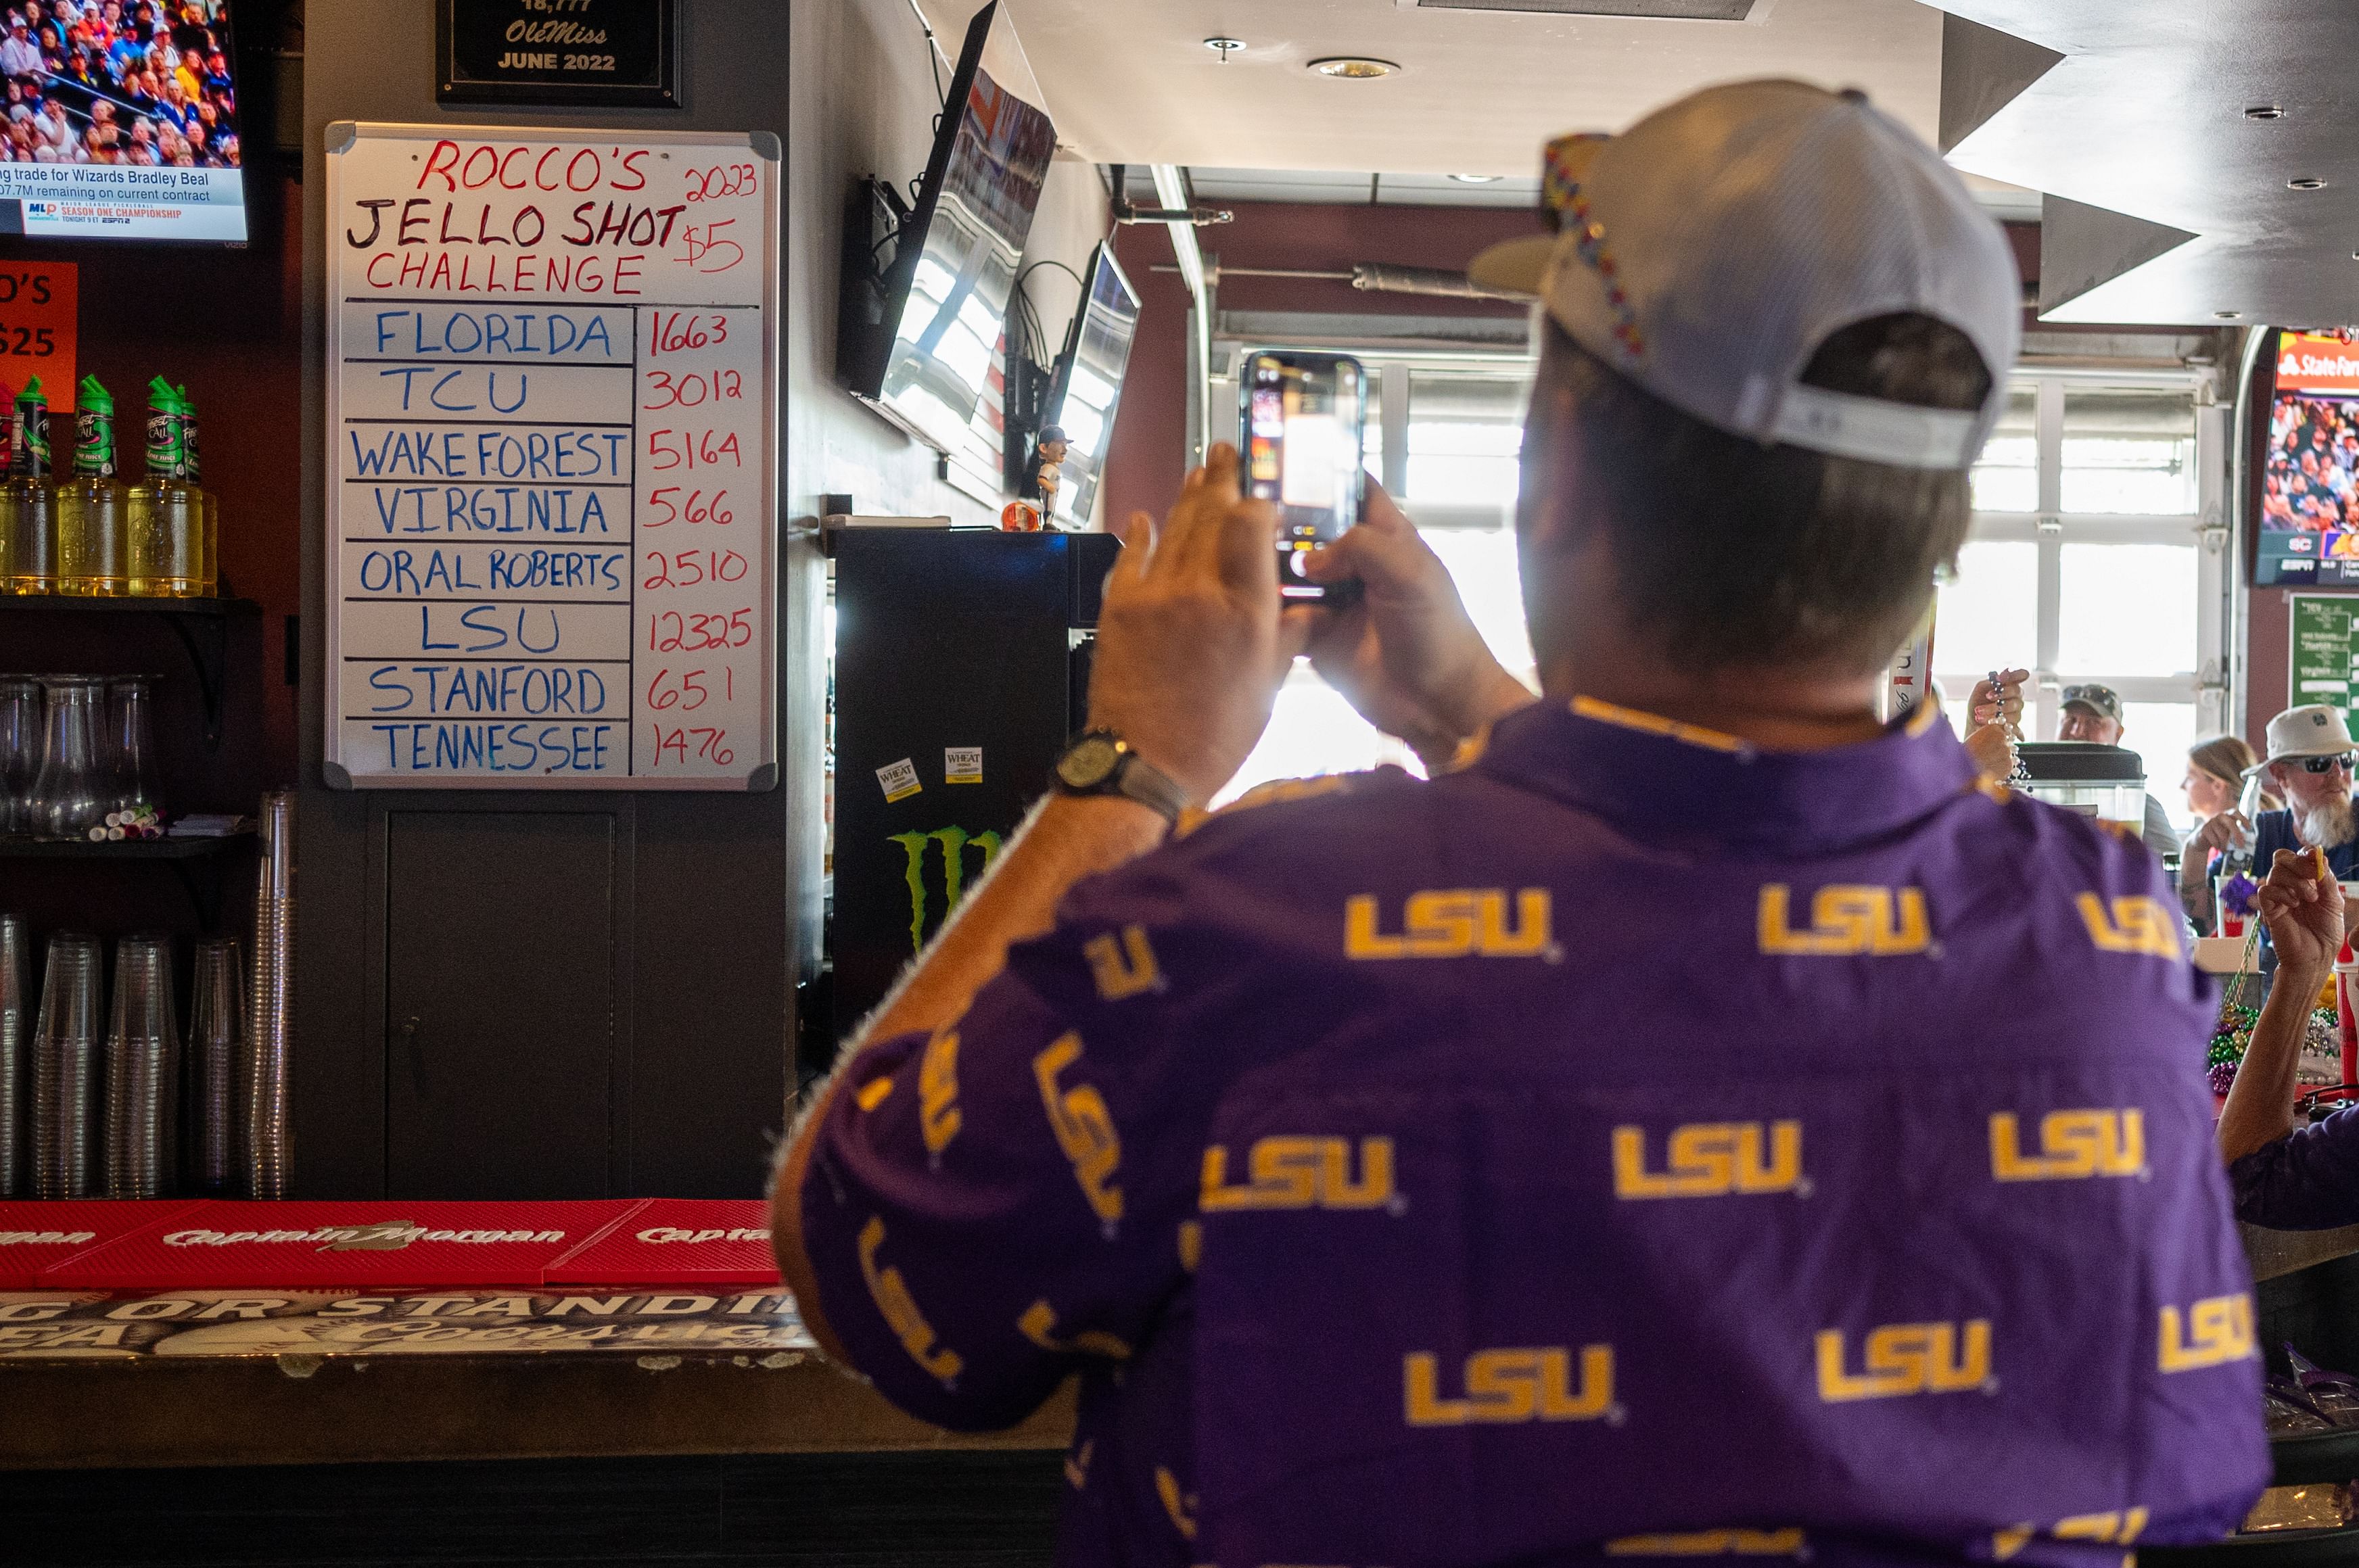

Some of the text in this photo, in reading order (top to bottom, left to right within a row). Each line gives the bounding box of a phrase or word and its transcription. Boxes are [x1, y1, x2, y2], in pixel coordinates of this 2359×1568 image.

[498, 53, 615, 70] JUNE 2022
[15, 168, 47, 181] trade
[51, 168, 69, 181] for
[72, 169, 124, 183] Wizards
[128, 170, 177, 187] Bradley
[181, 172, 209, 185] Beal
[417, 140, 650, 193] ROCCO'S
[685, 164, 757, 203] 2023
[37, 187, 95, 199] remaining
[99, 190, 114, 199] on
[118, 190, 159, 200] current
[162, 191, 210, 201] contract
[62, 207, 182, 218] SEASON ONE CHAMPIONSHIP
[347, 199, 687, 250] JELLO SHOT
[674, 218, 744, 273] $5
[367, 252, 646, 295] CHALLENGE
[377, 311, 728, 358] FLORIDA 1663
[380, 368, 742, 414] TCU 3012
[351, 429, 742, 479] WAKE FOREST 5164
[375, 487, 734, 534] VIRGINIA 566
[360, 550, 749, 596] ORAL ROBERTS 2510
[421, 605, 753, 654] LSU 12325
[369, 665, 733, 714] STANFORD 651
[371, 723, 735, 772] TENNESSEE 1476
[947, 754, 981, 763] WHEAT
[879, 765, 912, 784] WHEAT
[1345, 887, 1553, 959] LSU
[1757, 884, 1932, 955] LSU
[1612, 1120, 1802, 1199] LSU
[1989, 1108, 2145, 1181] LSU
[1199, 1136, 1395, 1210] LSU
[163, 1227, 565, 1248] Captain Morgan
[635, 1227, 772, 1244] Capta
[105, 1299, 289, 1319] OR
[2158, 1292, 2256, 1373] LSU
[1815, 1319, 1991, 1402] LSU
[1404, 1344, 1614, 1426] LSU
